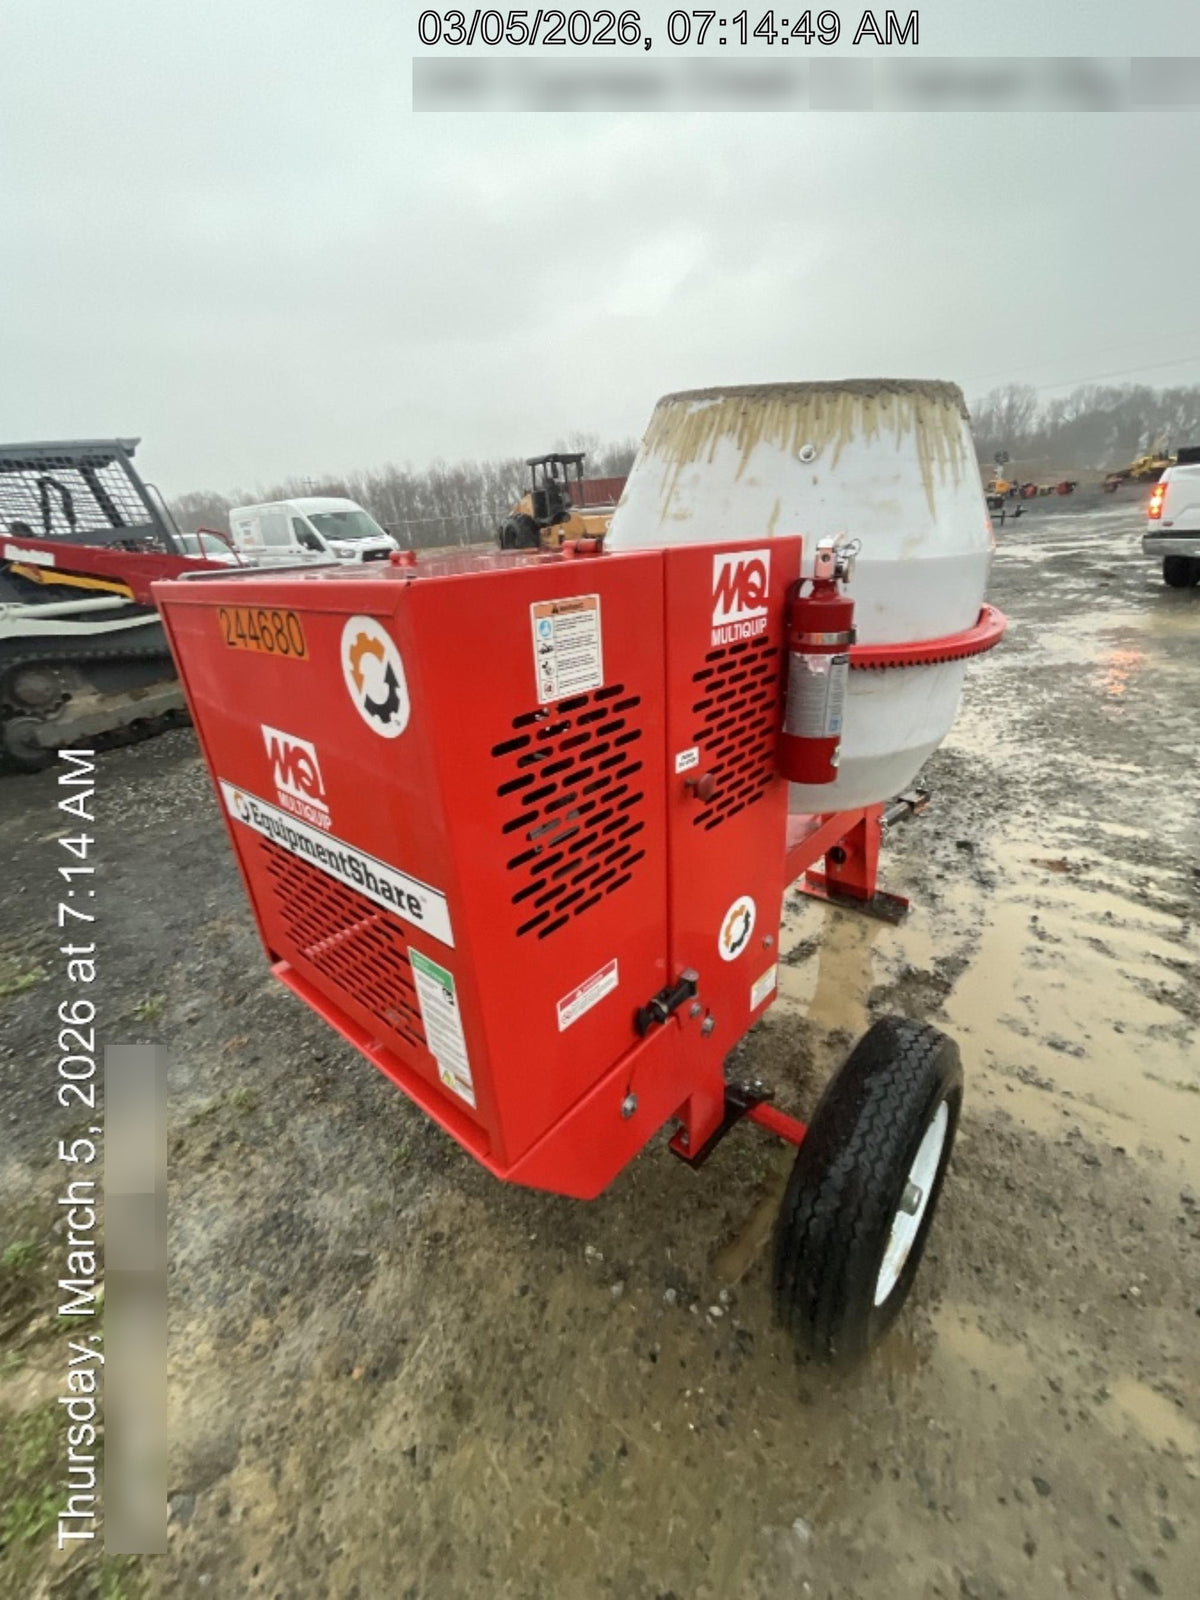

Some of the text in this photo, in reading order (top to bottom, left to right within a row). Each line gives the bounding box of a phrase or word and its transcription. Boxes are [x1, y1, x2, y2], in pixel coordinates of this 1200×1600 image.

[219, 607, 305, 657] 244680
[711, 617, 768, 647] MULTIQUIP
[248, 801, 425, 920] EquipmentShare
